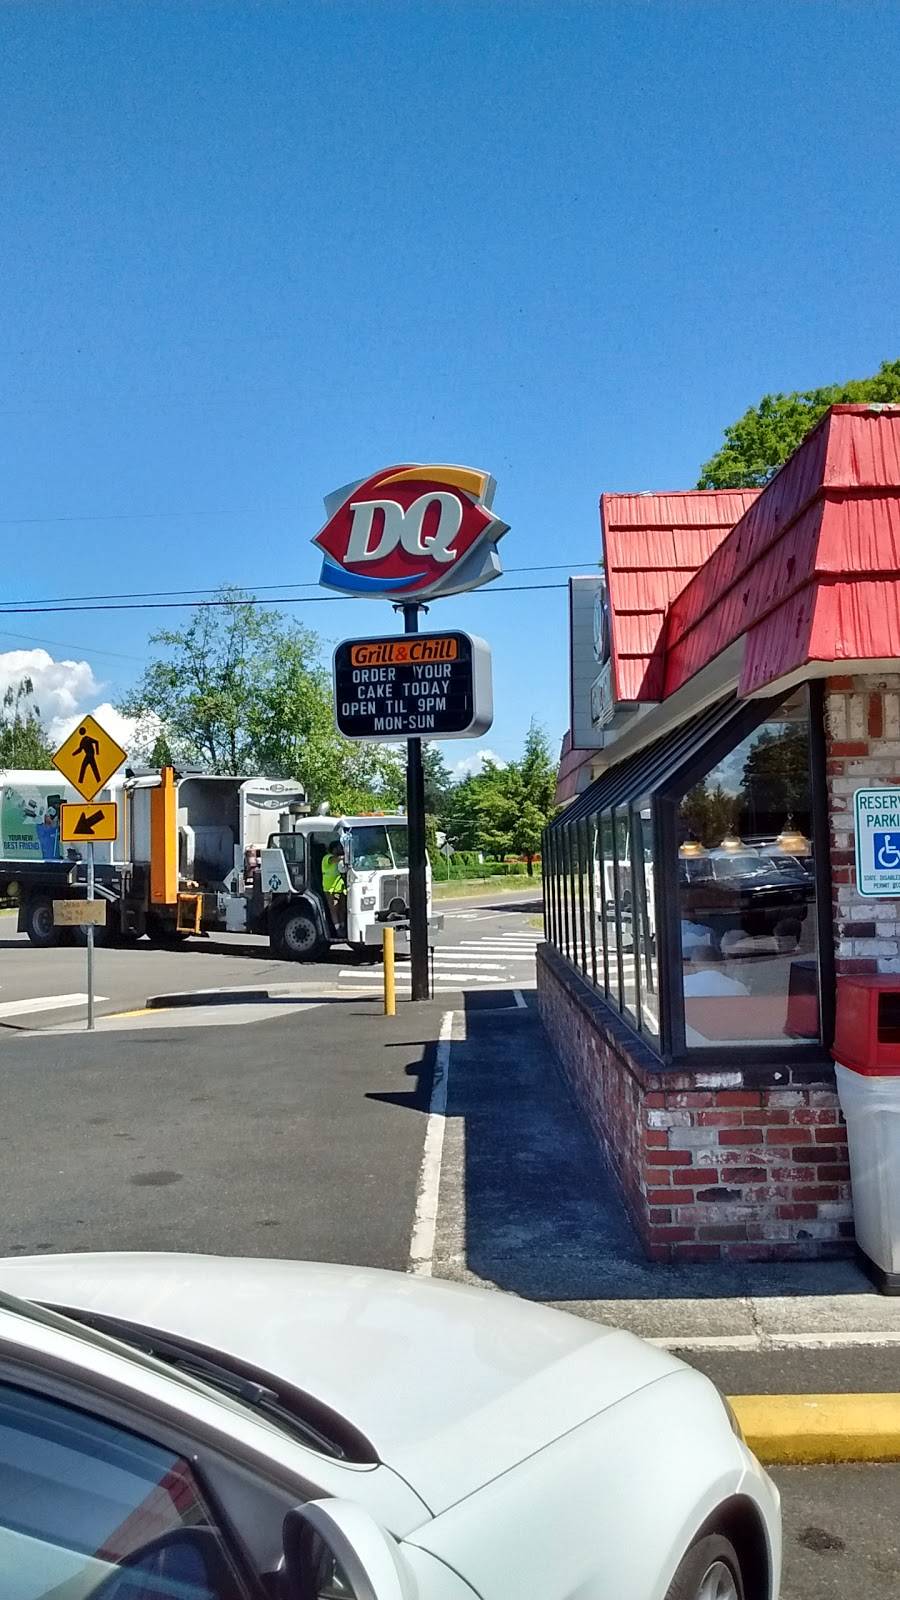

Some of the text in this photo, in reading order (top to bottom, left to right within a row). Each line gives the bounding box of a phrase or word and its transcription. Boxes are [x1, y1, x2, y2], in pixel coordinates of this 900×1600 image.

[343, 491, 464, 563] DQ
[352, 663, 452, 683] ORDER YOUR
[357, 680, 450, 699] CAKE TODAY
[341, 697, 447, 716] OPEN TIL 9PM
[374, 714, 435, 731] MON-SUN
[3, 841, 40, 850] BEST FRIEND
